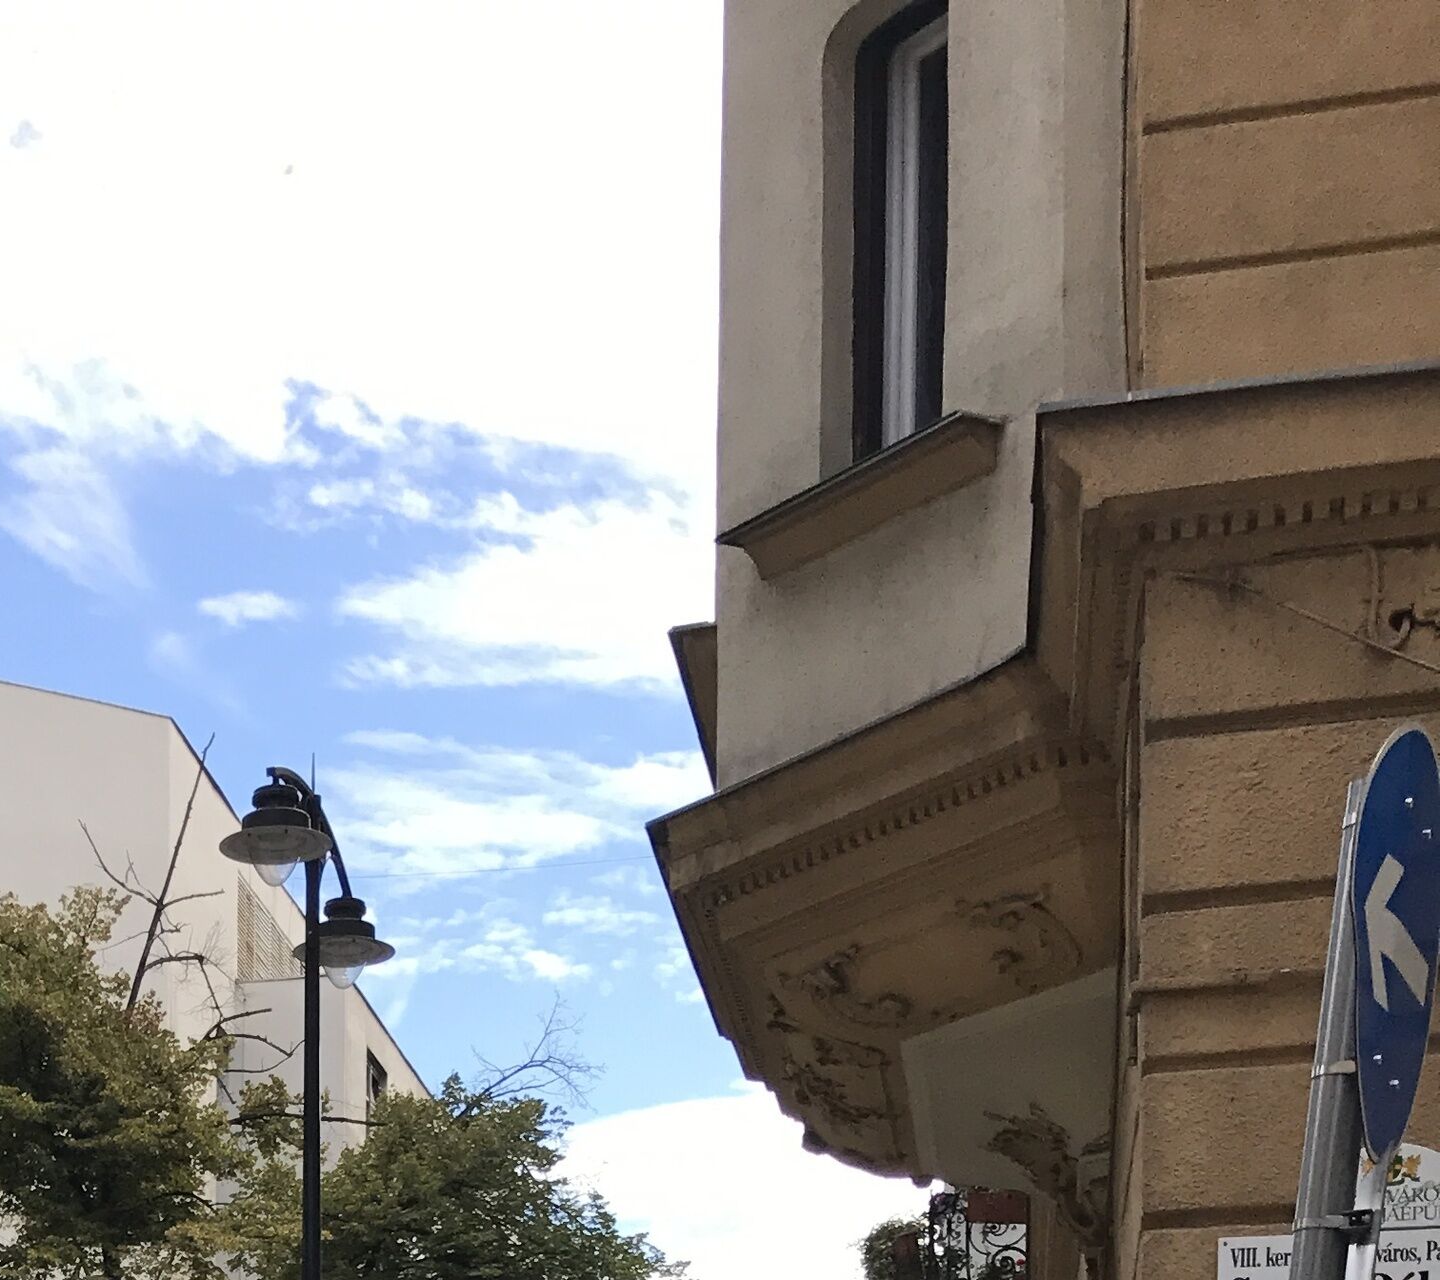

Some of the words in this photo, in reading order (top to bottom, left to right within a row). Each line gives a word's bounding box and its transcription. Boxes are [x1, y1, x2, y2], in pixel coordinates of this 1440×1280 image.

[1230, 1247, 1261, 1267] VIII.
[1265, 1246, 1292, 1267] ker
[1376, 1242, 1422, 1264] város,
